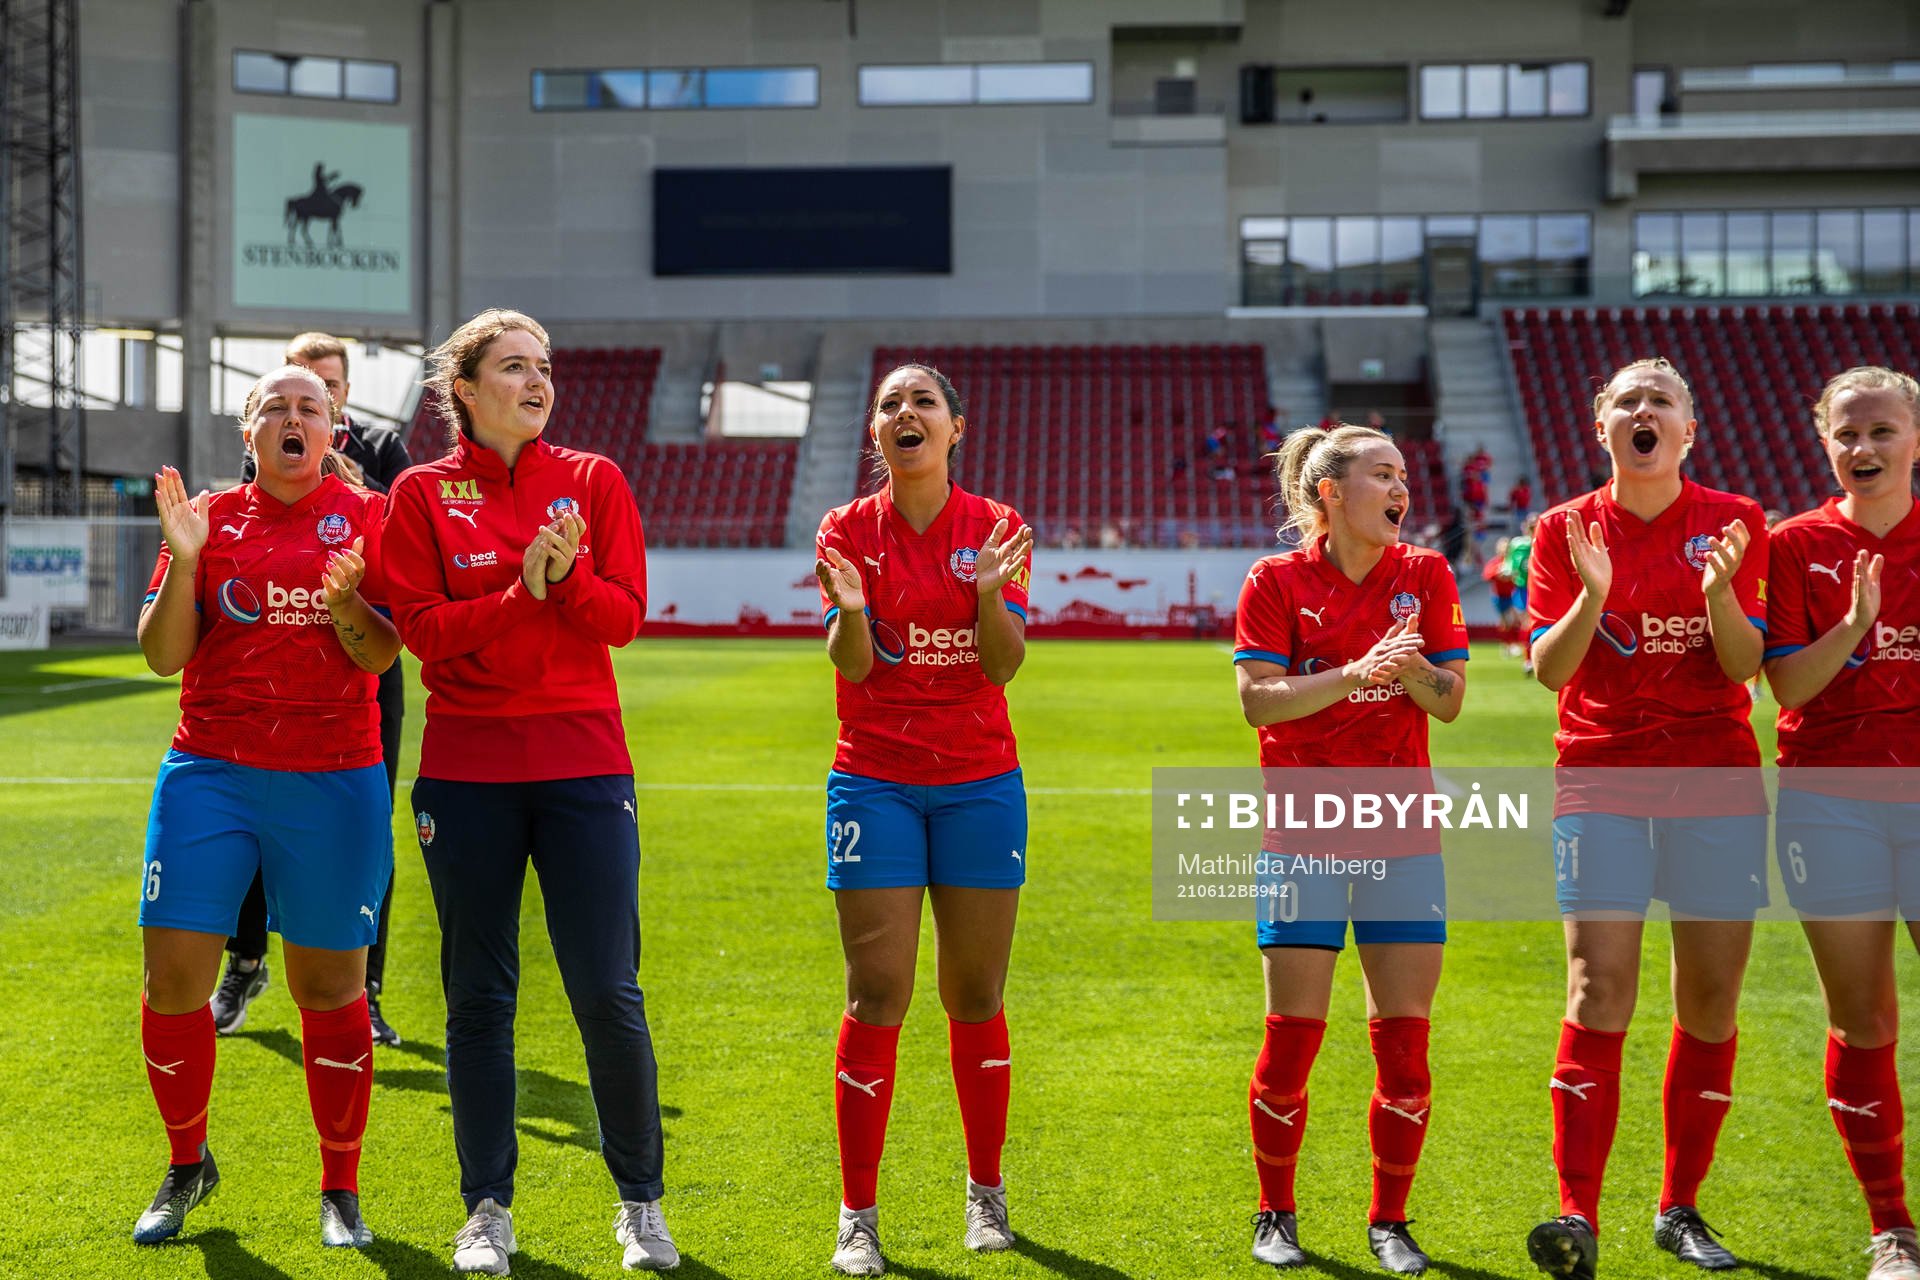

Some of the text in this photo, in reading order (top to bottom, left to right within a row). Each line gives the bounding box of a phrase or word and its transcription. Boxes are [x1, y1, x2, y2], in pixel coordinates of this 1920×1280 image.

[242, 244, 400, 272] STENBOCKEN
[439, 479, 483, 499] XXL
[470, 551, 497, 562] beat
[470, 559, 498, 568] diabetes
[267, 580, 330, 611] bea
[267, 609, 334, 626] diabete
[831, 821, 861, 862] 22
[1556, 836, 1580, 881] 21
[1788, 841, 1807, 884] 6
[141, 860, 162, 902] 6
[1267, 881, 1299, 923] 10
